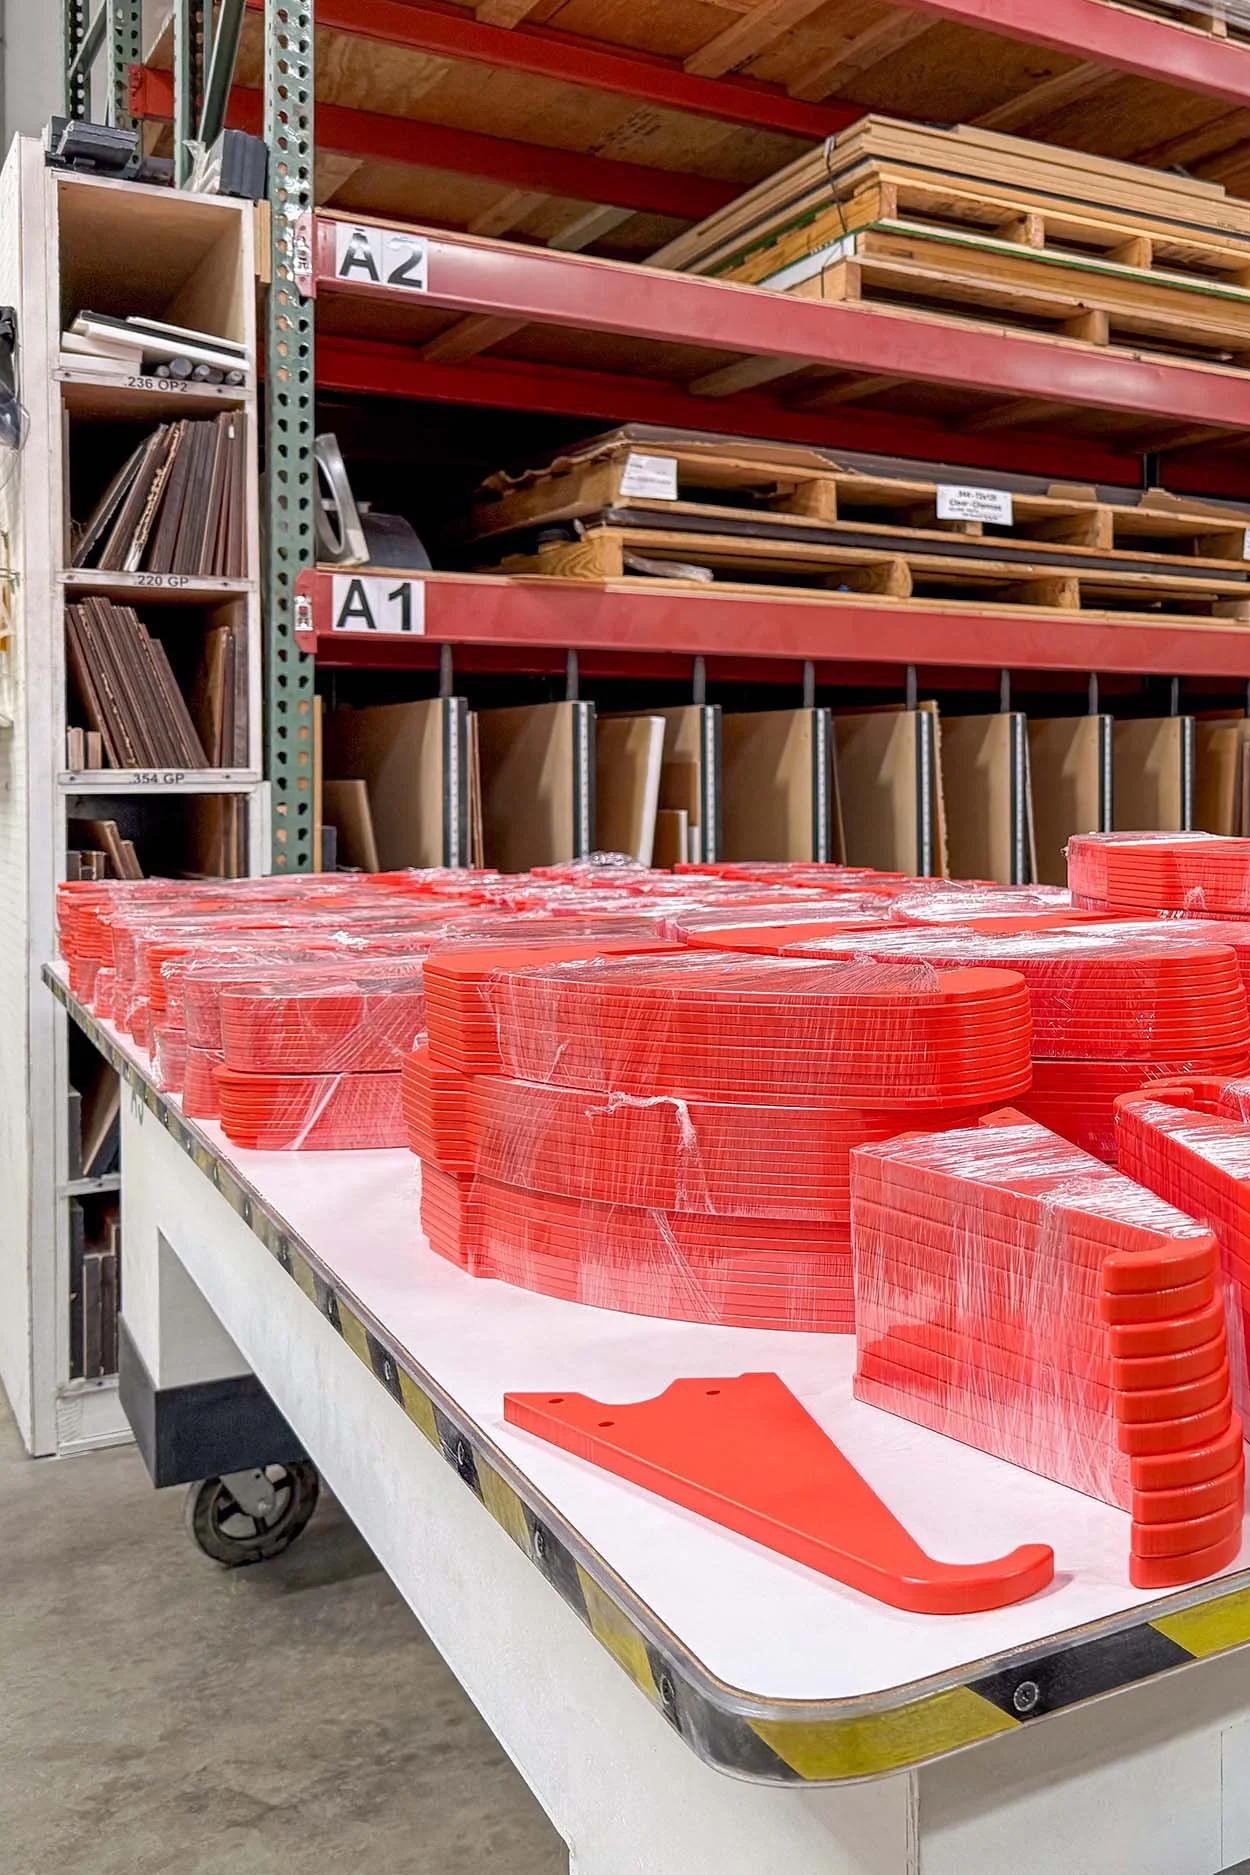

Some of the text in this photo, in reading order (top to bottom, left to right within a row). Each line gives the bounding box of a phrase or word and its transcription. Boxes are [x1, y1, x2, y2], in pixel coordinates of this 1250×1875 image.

[338, 227, 423, 289] A2
[124, 376, 188, 393] .236 OP2
[167, 575, 190, 588] GP
[335, 578, 413, 632] A1
[163, 772, 185, 785] GP
